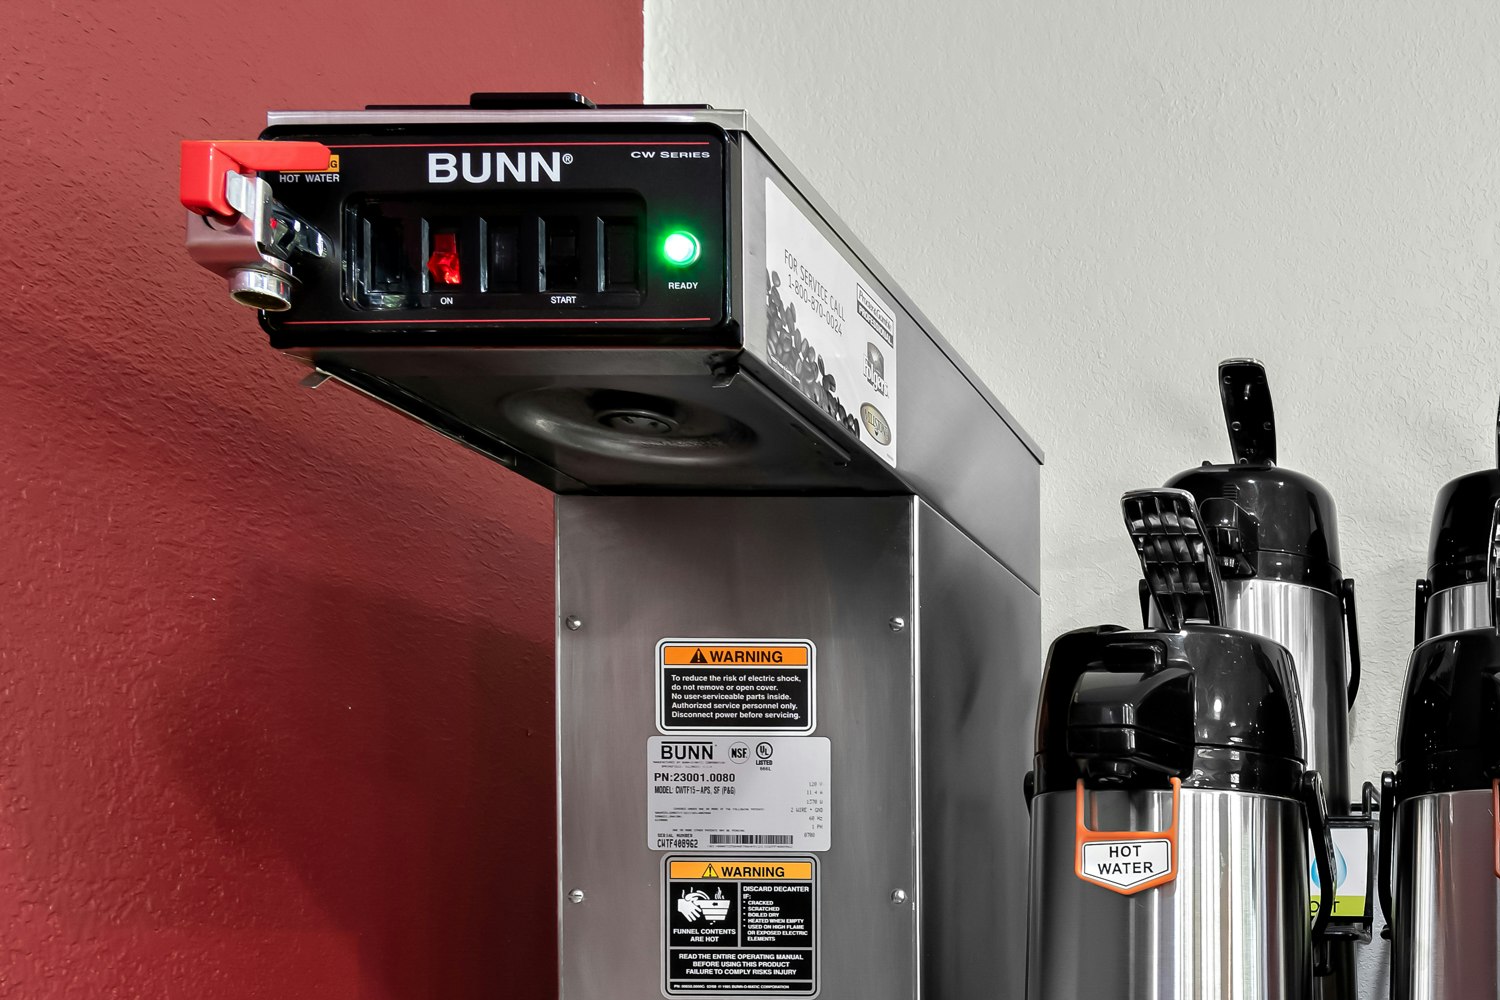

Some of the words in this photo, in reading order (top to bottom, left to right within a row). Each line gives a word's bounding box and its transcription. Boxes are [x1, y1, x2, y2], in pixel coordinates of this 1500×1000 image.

[280, 174, 300, 183] HOT
[305, 174, 340, 182] WATER
[668, 282, 698, 290] READY
[784, 249, 798, 276] FOR
[800, 264, 828, 302] SERVICE
[830, 295, 845, 322] CALL
[788, 273, 843, 336] 1-800-870-0024
[710, 651, 783, 663] WARNING
[742, 702, 778, 710] personnel
[765, 712, 800, 720] servicing.
[661, 745, 713, 760] BUNN
[654, 772, 735, 782] PN:23001.0080
[654, 786, 673, 794] MODEL:
[1109, 845, 1141, 858] HOT
[721, 867, 785, 878] WARNING
[1097, 861, 1154, 875] WATER
